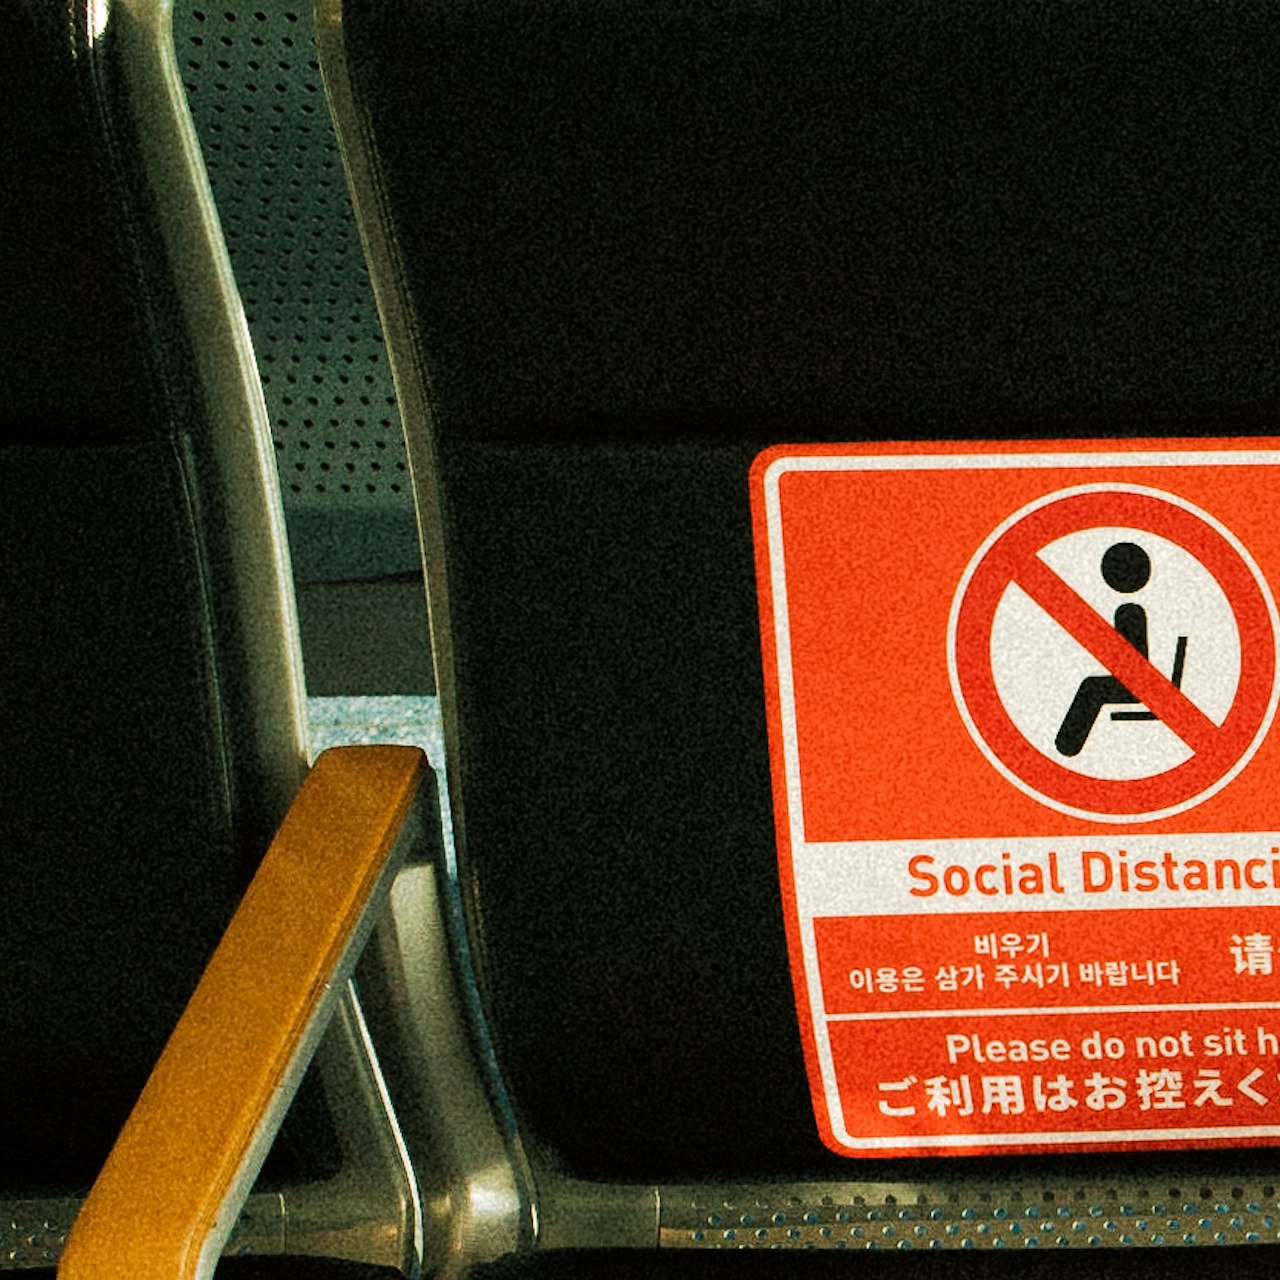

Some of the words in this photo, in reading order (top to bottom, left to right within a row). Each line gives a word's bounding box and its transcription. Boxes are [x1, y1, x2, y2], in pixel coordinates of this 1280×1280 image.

[908, 852, 1064, 897] Social
[973, 932, 1050, 959] 비우기
[849, 966, 925, 993] 이용은
[934, 964, 985, 991] 삼가
[995, 962, 1070, 989] 주시기
[1078, 959, 1180, 987] 바랍니다
[946, 1034, 1071, 1064] Please
[1081, 1030, 1125, 1060] do
[1135, 1030, 1194, 1058] not
[1203, 1027, 1248, 1057] sit
